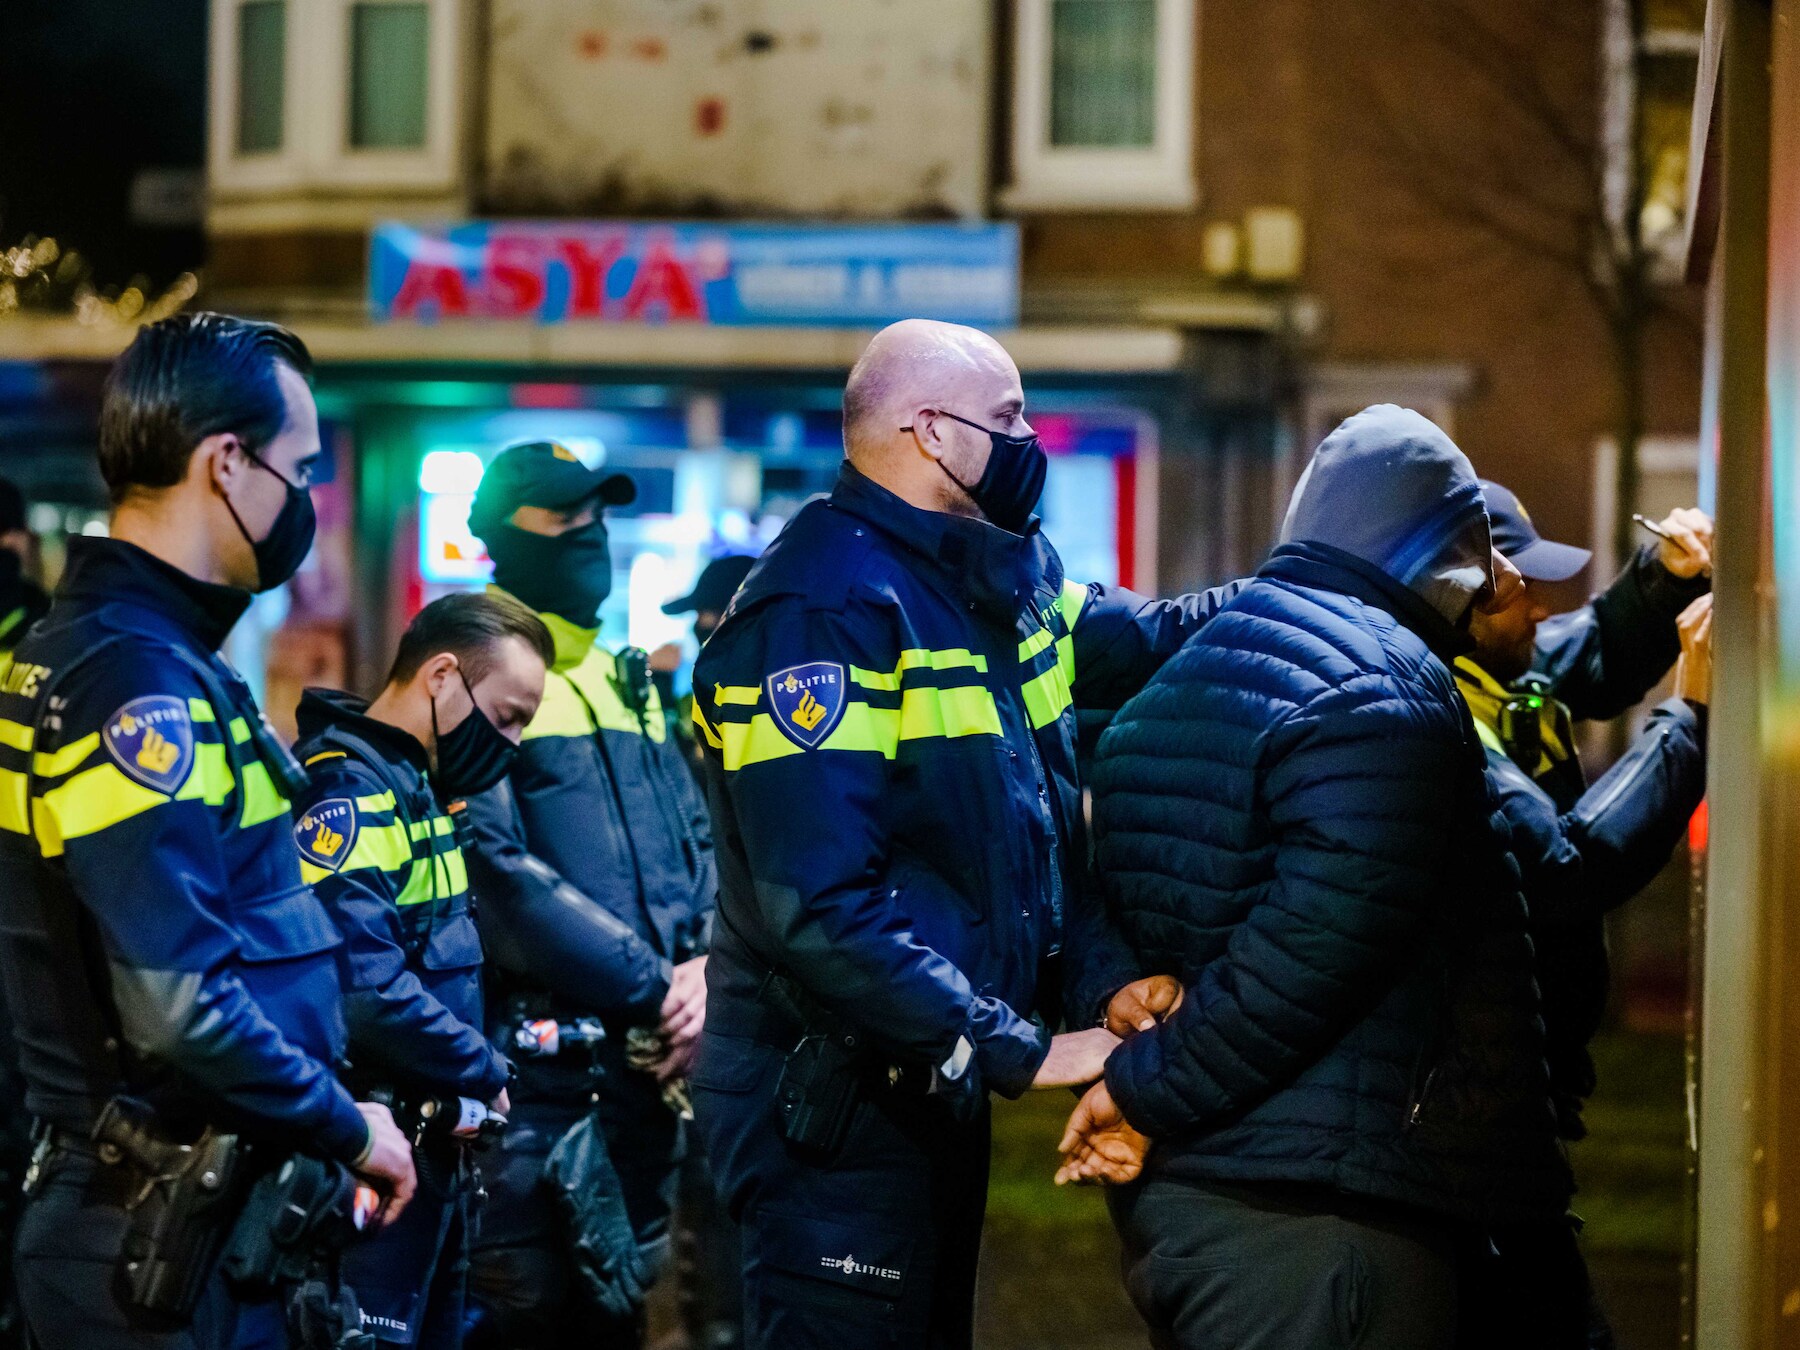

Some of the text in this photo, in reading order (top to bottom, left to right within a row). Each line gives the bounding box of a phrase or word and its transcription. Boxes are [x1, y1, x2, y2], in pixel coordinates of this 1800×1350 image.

[391, 228, 707, 321] ASYA
[1042, 601, 1062, 622] ITIE
[777, 674, 836, 694] POLITIE
[110, 707, 182, 738] POLITIE
[297, 806, 347, 833] POLITIE
[835, 1256, 888, 1278] POLITIE
[359, 1311, 397, 1329] LITIE
